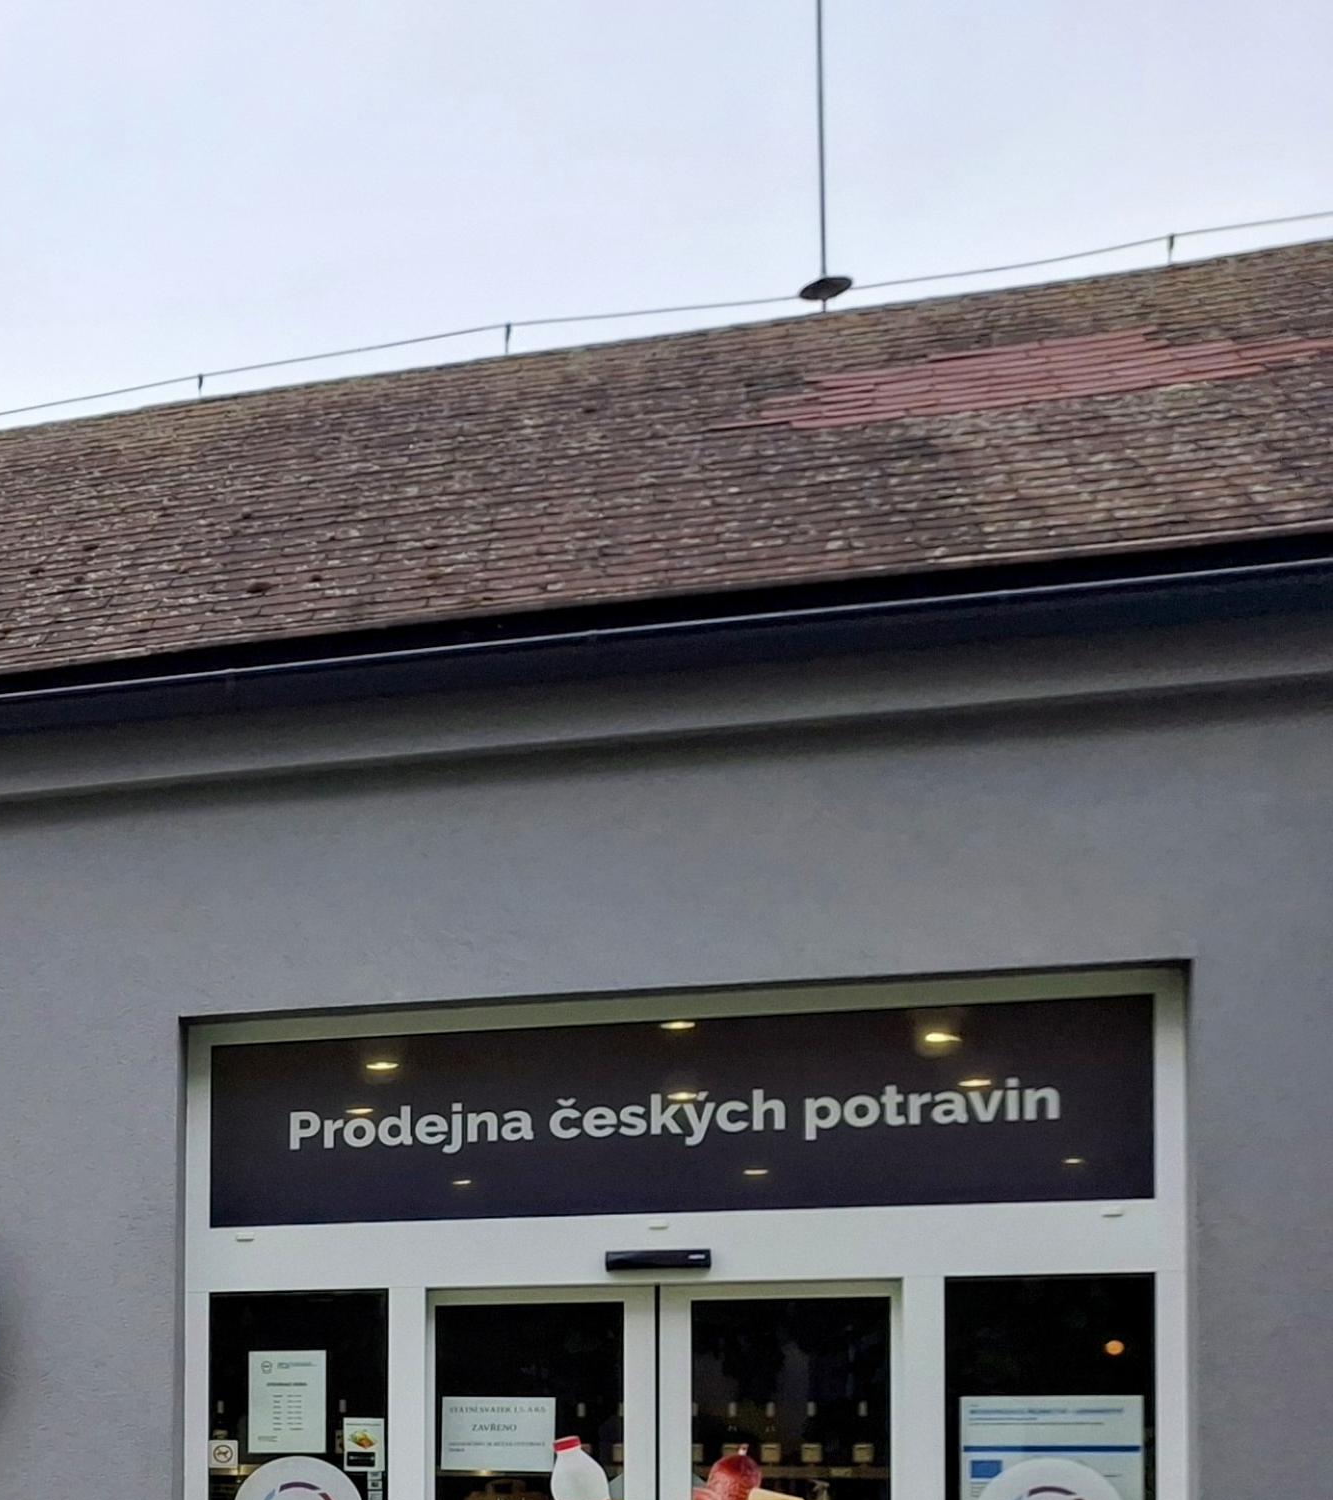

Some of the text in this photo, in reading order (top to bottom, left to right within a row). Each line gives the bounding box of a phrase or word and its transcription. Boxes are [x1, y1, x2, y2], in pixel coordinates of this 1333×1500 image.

[289, 1077, 1061, 1154] Prodejna českých potravin
